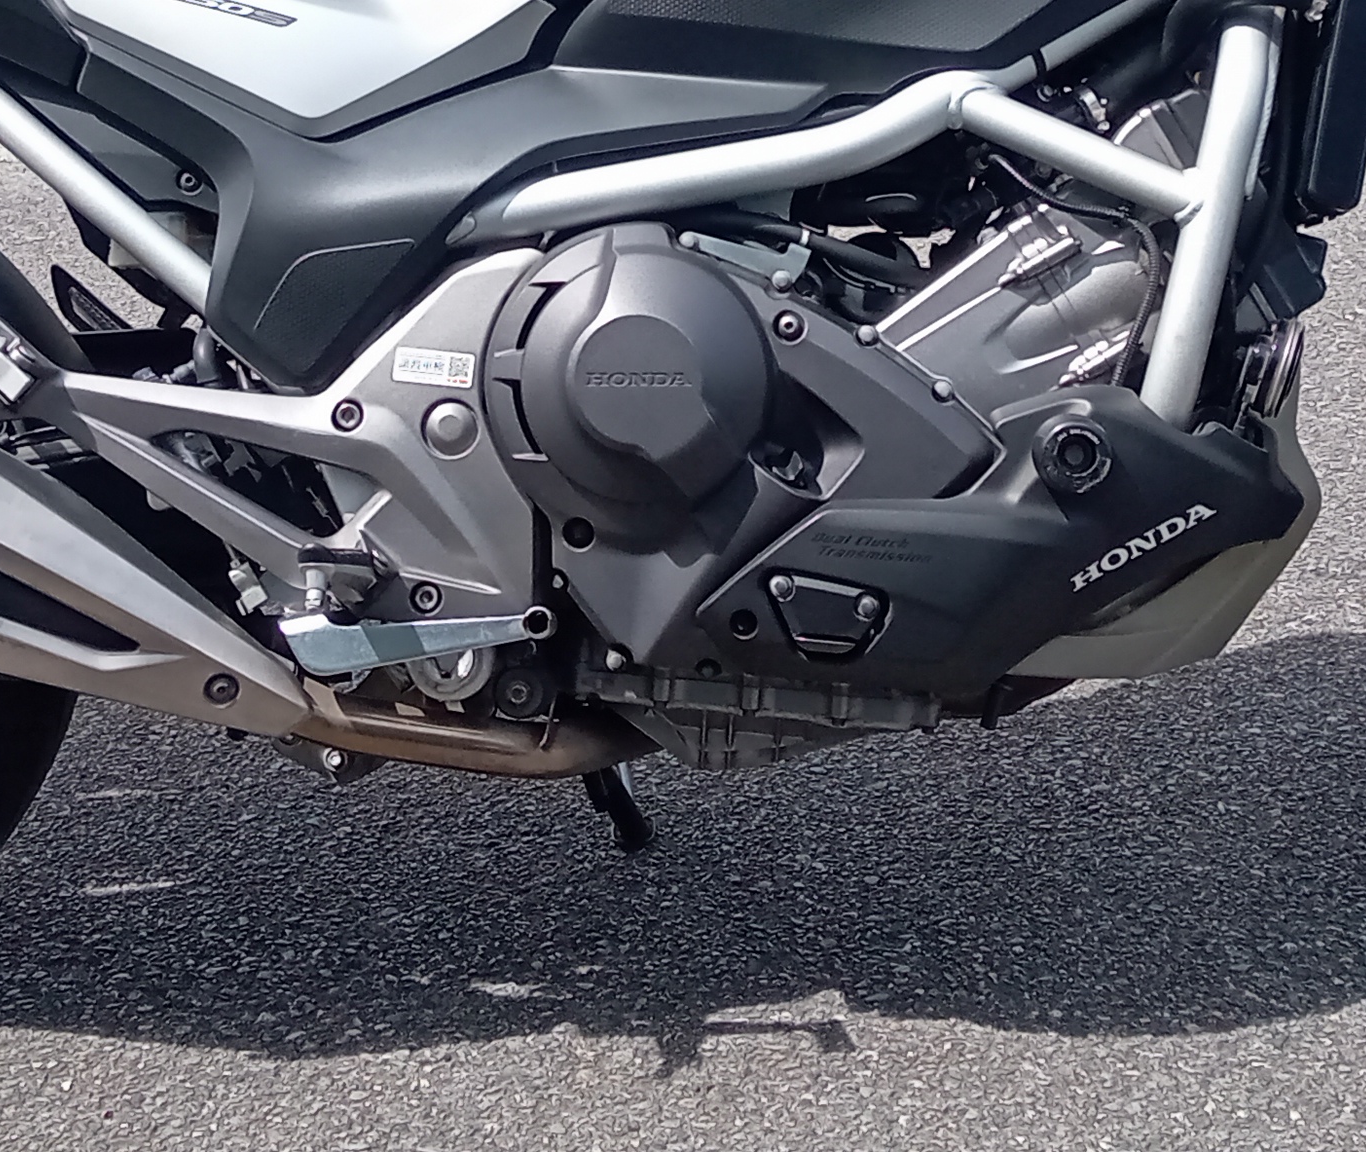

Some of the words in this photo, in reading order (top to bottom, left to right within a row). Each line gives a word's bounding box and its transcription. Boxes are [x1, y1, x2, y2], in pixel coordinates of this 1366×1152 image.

[585, 371, 693, 388] HONDA
[811, 531, 853, 545] Dual
[855, 534, 910, 548] Clutch
[1069, 503, 1218, 593] HONDA
